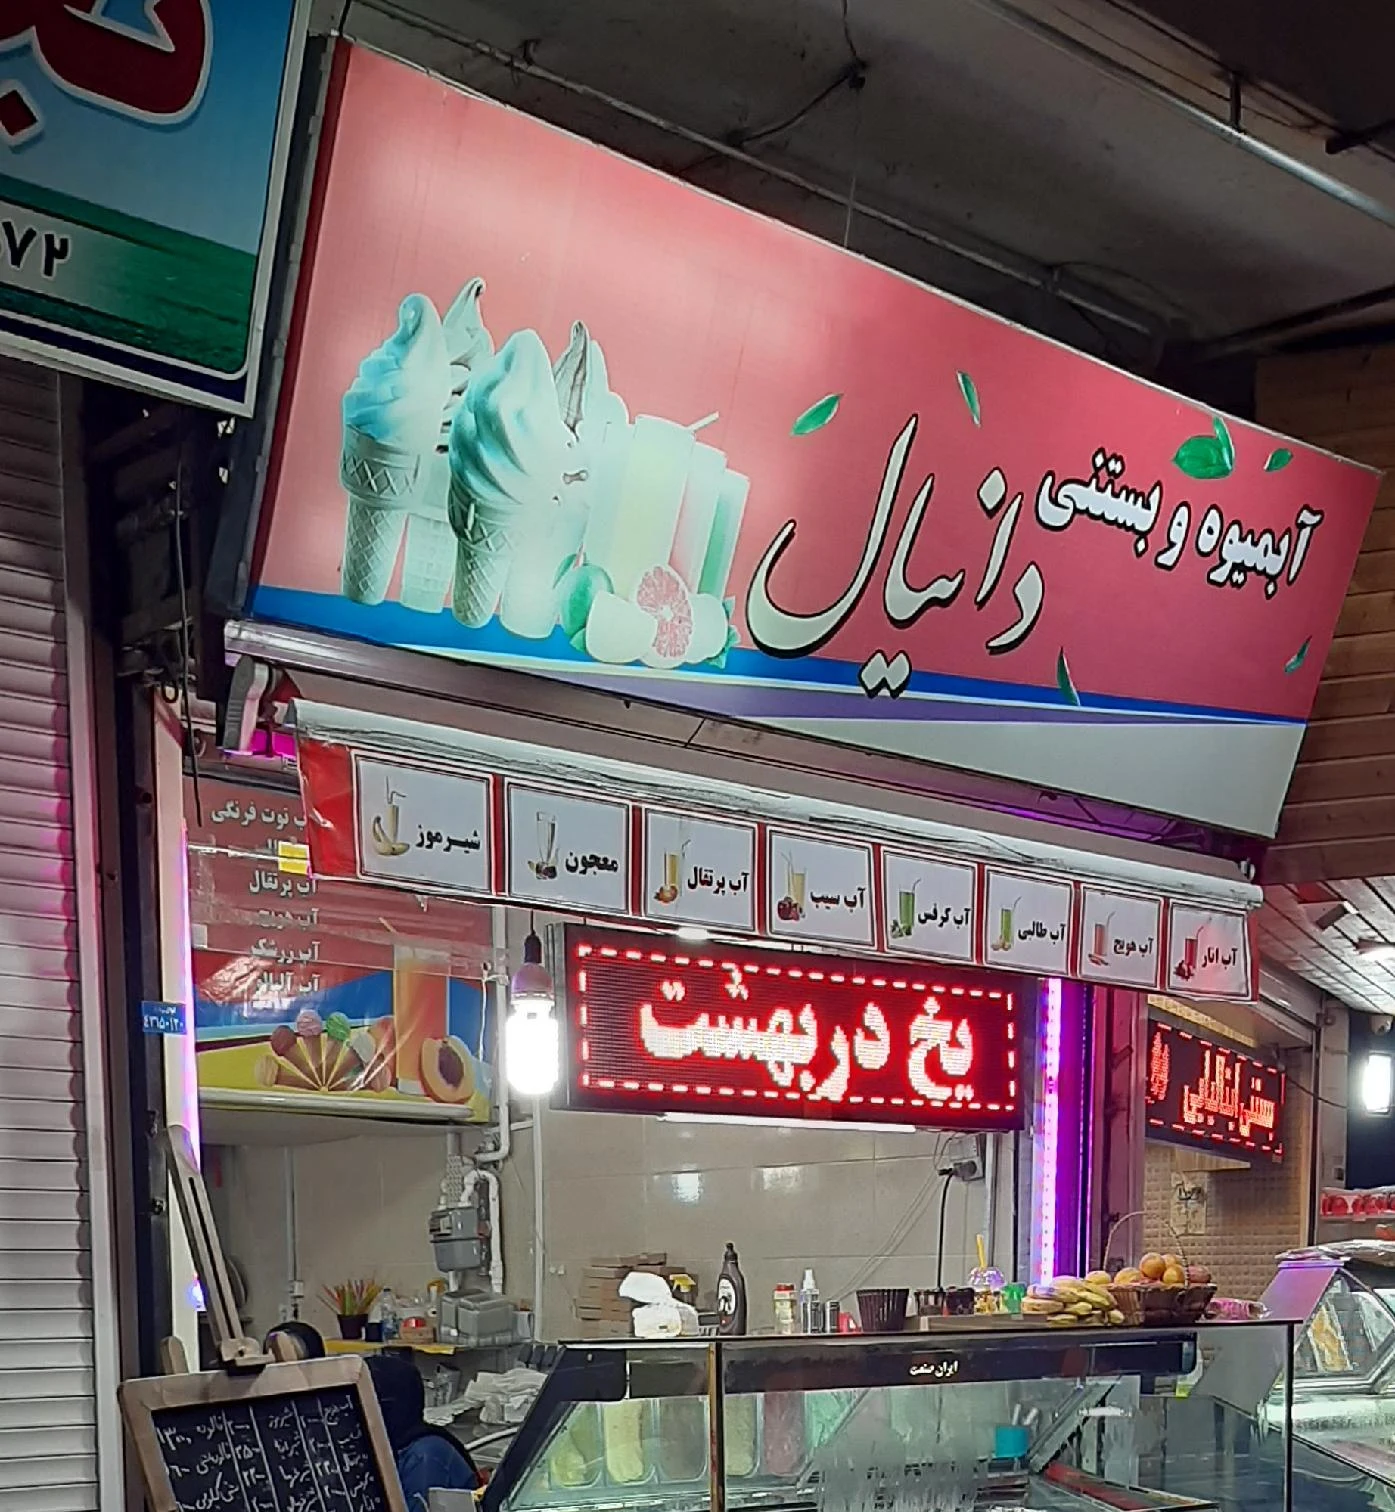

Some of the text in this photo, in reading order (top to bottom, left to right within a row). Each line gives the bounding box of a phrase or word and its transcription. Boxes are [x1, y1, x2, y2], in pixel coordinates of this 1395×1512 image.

[1036, 448, 1324, 599] آبمیوه و بستنی
[745, 413, 1044, 698] دانیال
[211, 799, 307, 831] ب توت فرنگی
[565, 851, 619, 876] معجون
[249, 869, 292, 897] پرتقال
[687, 866, 750, 895] آب پرتقال
[810, 887, 866, 912] آب سیب
[298, 907, 320, 931] آب
[917, 902, 971, 928] آب کرفس
[1017, 921, 1067, 944] آب طالبی
[299, 940, 321, 966] آب
[1113, 937, 1154, 957] آب هویج
[1202, 946, 1238, 968] آب انار
[299, 973, 321, 996] آب
[907, 996, 975, 1101] یخ
[909, 1359, 959, 1377] ایران صنعت
